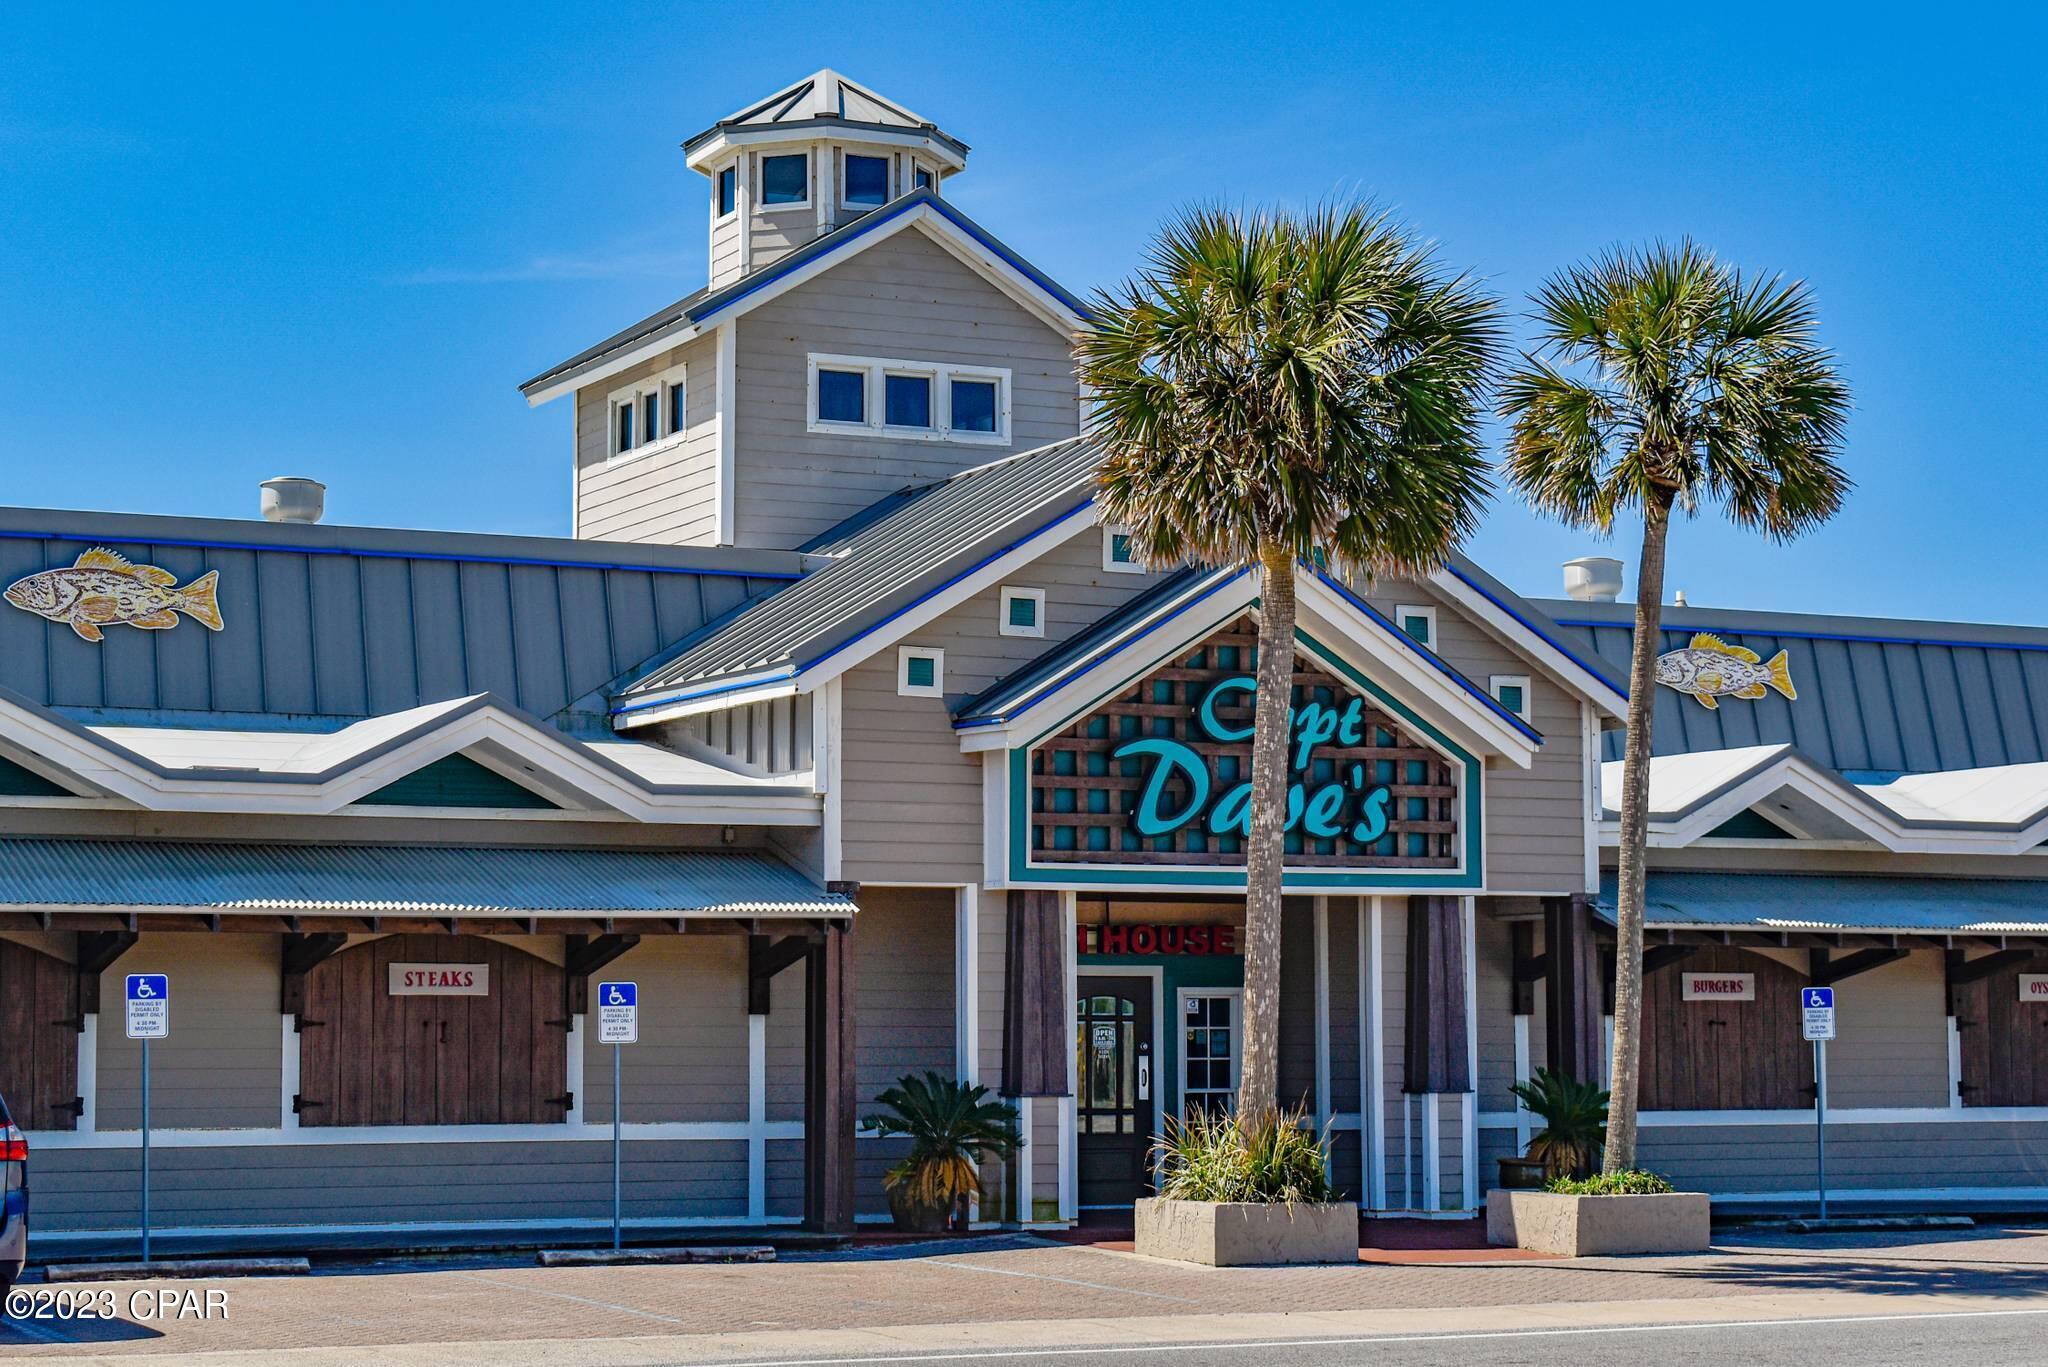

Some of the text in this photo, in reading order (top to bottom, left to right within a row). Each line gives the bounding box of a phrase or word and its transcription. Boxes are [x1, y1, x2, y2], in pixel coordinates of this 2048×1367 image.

[1201, 677, 1362, 769] Cpt
[1102, 924, 1235, 955] HOUSE
[404, 971, 473, 987] STEAKS
[1693, 980, 1744, 993] BURGERS
